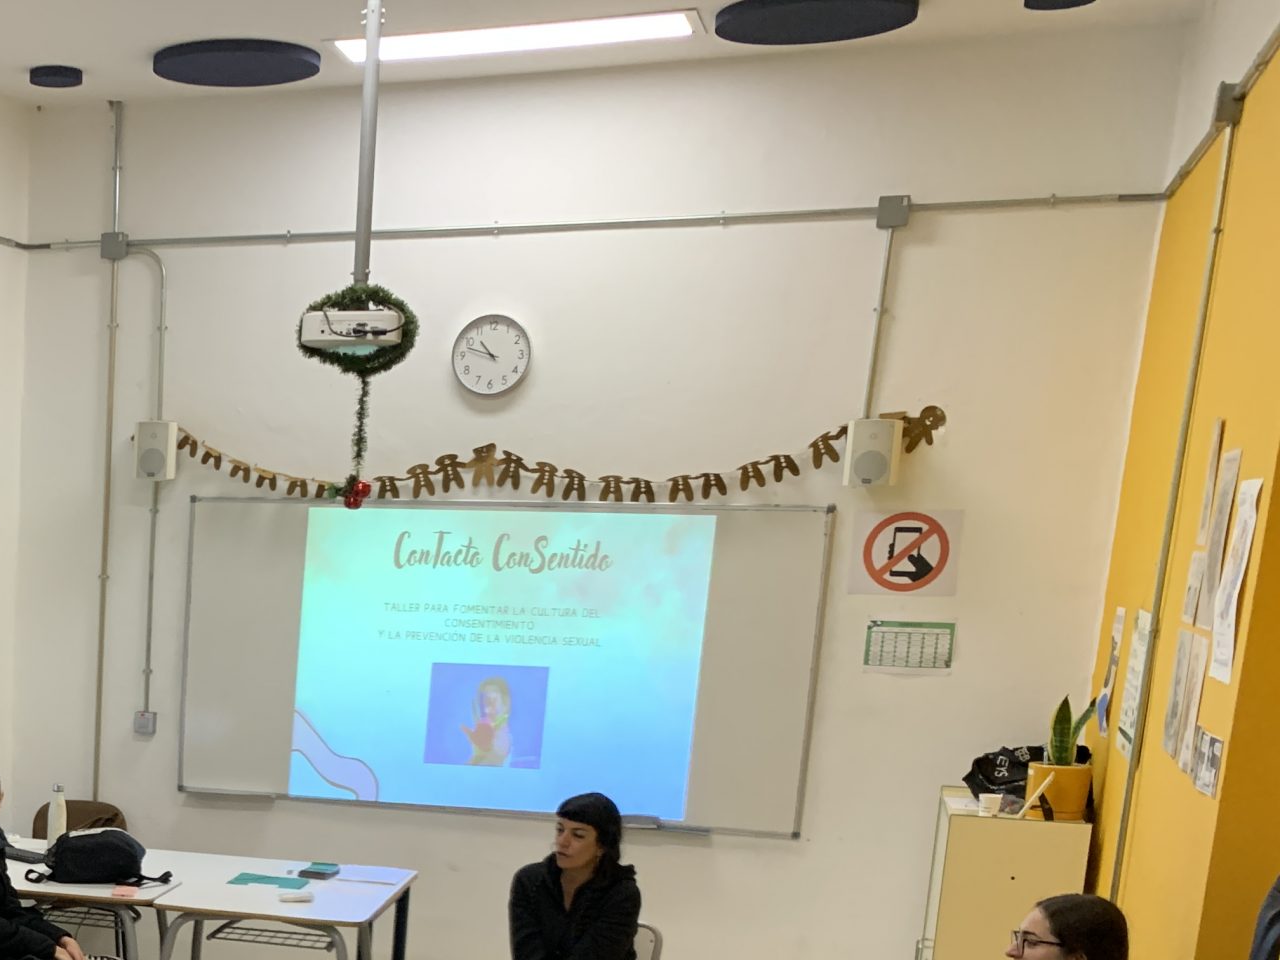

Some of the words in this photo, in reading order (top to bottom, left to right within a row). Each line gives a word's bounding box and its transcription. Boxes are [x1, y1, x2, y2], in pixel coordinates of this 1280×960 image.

[465, 337, 475, 347] 10
[514, 334, 521, 345] 2
[518, 349, 524, 360] 3
[463, 365, 470, 375] 8
[486, 379, 493, 390] 6
[393, 530, 483, 570] ConTacto
[491, 532, 614, 575] ConSentido
[383, 601, 421, 613] TALLER
[423, 602, 449, 614] PARA
[452, 603, 511, 616] FOMENTAR
[512, 605, 527, 616] LA
[530, 606, 578, 618] CULTURA
[581, 607, 601, 619] DEL
[443, 617, 536, 631] CONSENTIMIENTO
[377, 629, 386, 640] Y
[387, 630, 402, 640] LA
[469, 632, 483, 643] DE
[486, 633, 500, 644] LA
[504, 634, 558, 646] VIOLENCIA
[561, 636, 603, 648] SEXUAL
